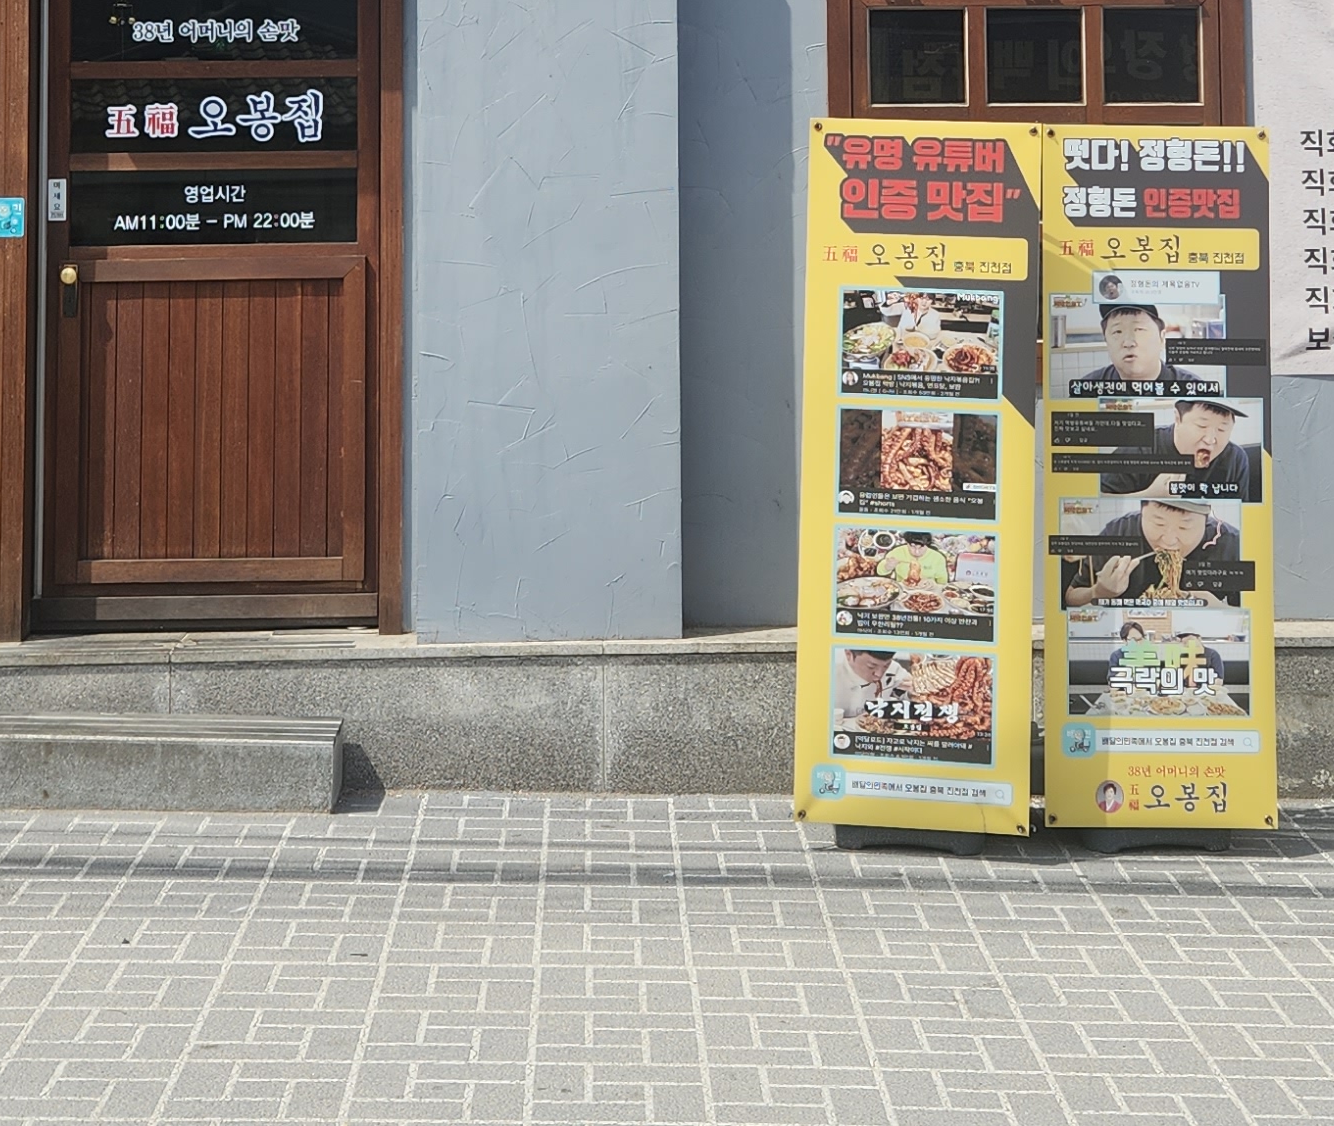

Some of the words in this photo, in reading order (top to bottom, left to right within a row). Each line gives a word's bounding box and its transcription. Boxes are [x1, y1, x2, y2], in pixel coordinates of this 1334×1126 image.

[132, 20, 174, 42] 38년
[179, 19, 253, 43] 어머니의
[257, 18, 300, 42] 손맛
[105, 103, 179, 138] 五福
[188, 90, 324, 142] 오봉집
[826, 135, 903, 170] "유명
[913, 138, 1005, 173] 유튜버
[1139, 137, 1245, 173] 정형돈!!
[184, 185, 246, 203] 영업시간
[842, 178, 918, 220] 인증
[927, 180, 1021, 223] 맛집"
[1062, 185, 1137, 218] 정형돈
[1144, 187, 1240, 219] 인증맛집
[114, 213, 200, 231] AM11:00분
[223, 214, 247, 229] PM
[253, 212, 315, 229] 22:00분
[865, 242, 946, 272] 오봉집
[979, 261, 1012, 274] 진천점
[1100, 235, 1180, 264] 오봉집
[1213, 252, 1244, 264] 진천점
[956, 293, 999, 304] Mukbang
[1071, 380, 1127, 395] 살아생전에
[1131, 380, 1166, 396] 먹어볼
[1170, 381, 1181, 395] 수
[1186, 381, 1219, 396] 있어서
[1211, 482, 1238, 495] 납니다
[1109, 666, 1184, 695] 극락의
[1192, 666, 1218, 696] 맛
[865, 698, 960, 724] 낙지전쟁
[1128, 765, 1152, 778] 38년
[1156, 765, 1199, 778] 어머니의
[1203, 765, 1226, 778] 손맛
[1143, 781, 1227, 813] 오봉집
